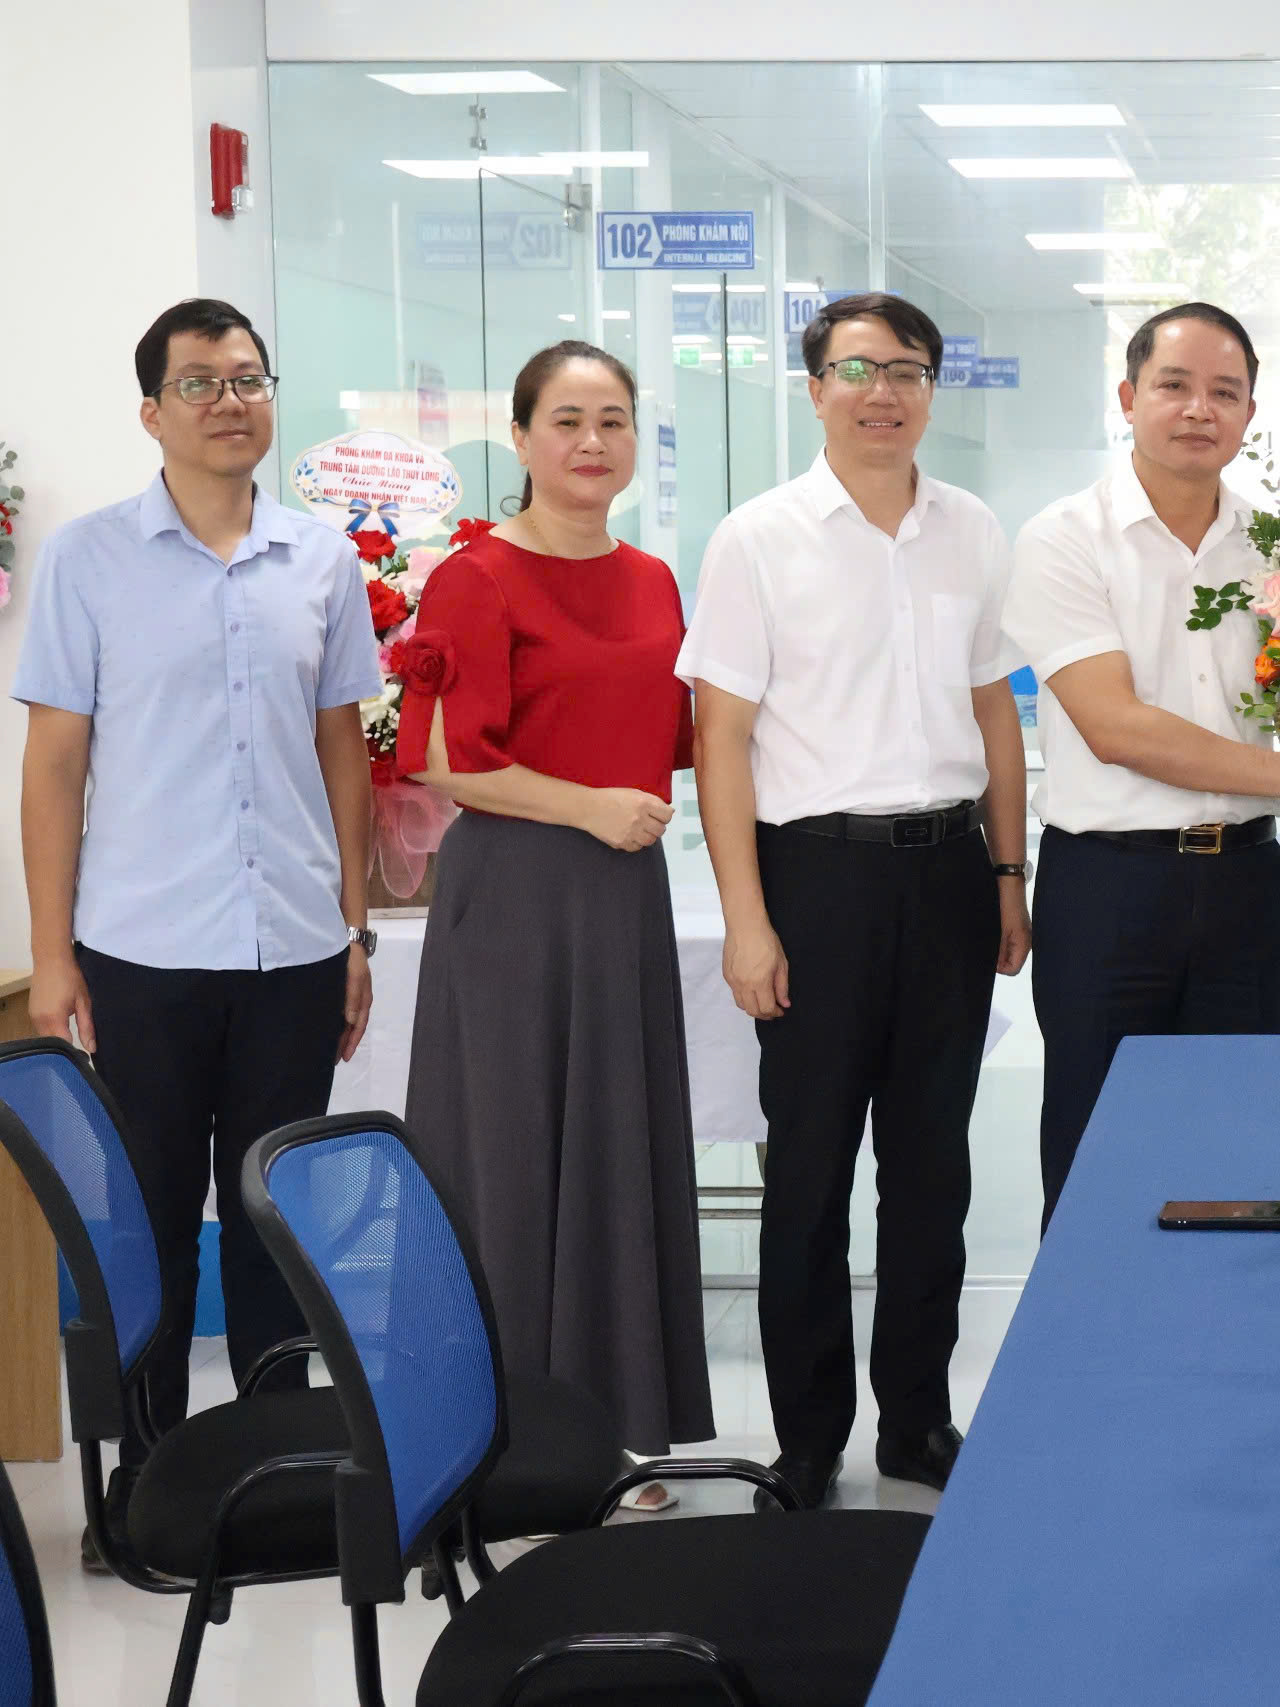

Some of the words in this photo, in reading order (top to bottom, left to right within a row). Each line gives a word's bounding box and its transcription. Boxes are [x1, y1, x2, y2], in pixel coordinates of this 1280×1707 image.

[607, 222, 652, 258] 102
[699, 221, 729, 242] KHÁM
[320, 461, 343, 472] TRUNG
[421, 471, 440, 482] LONG
[344, 489, 369, 501] DOANH
